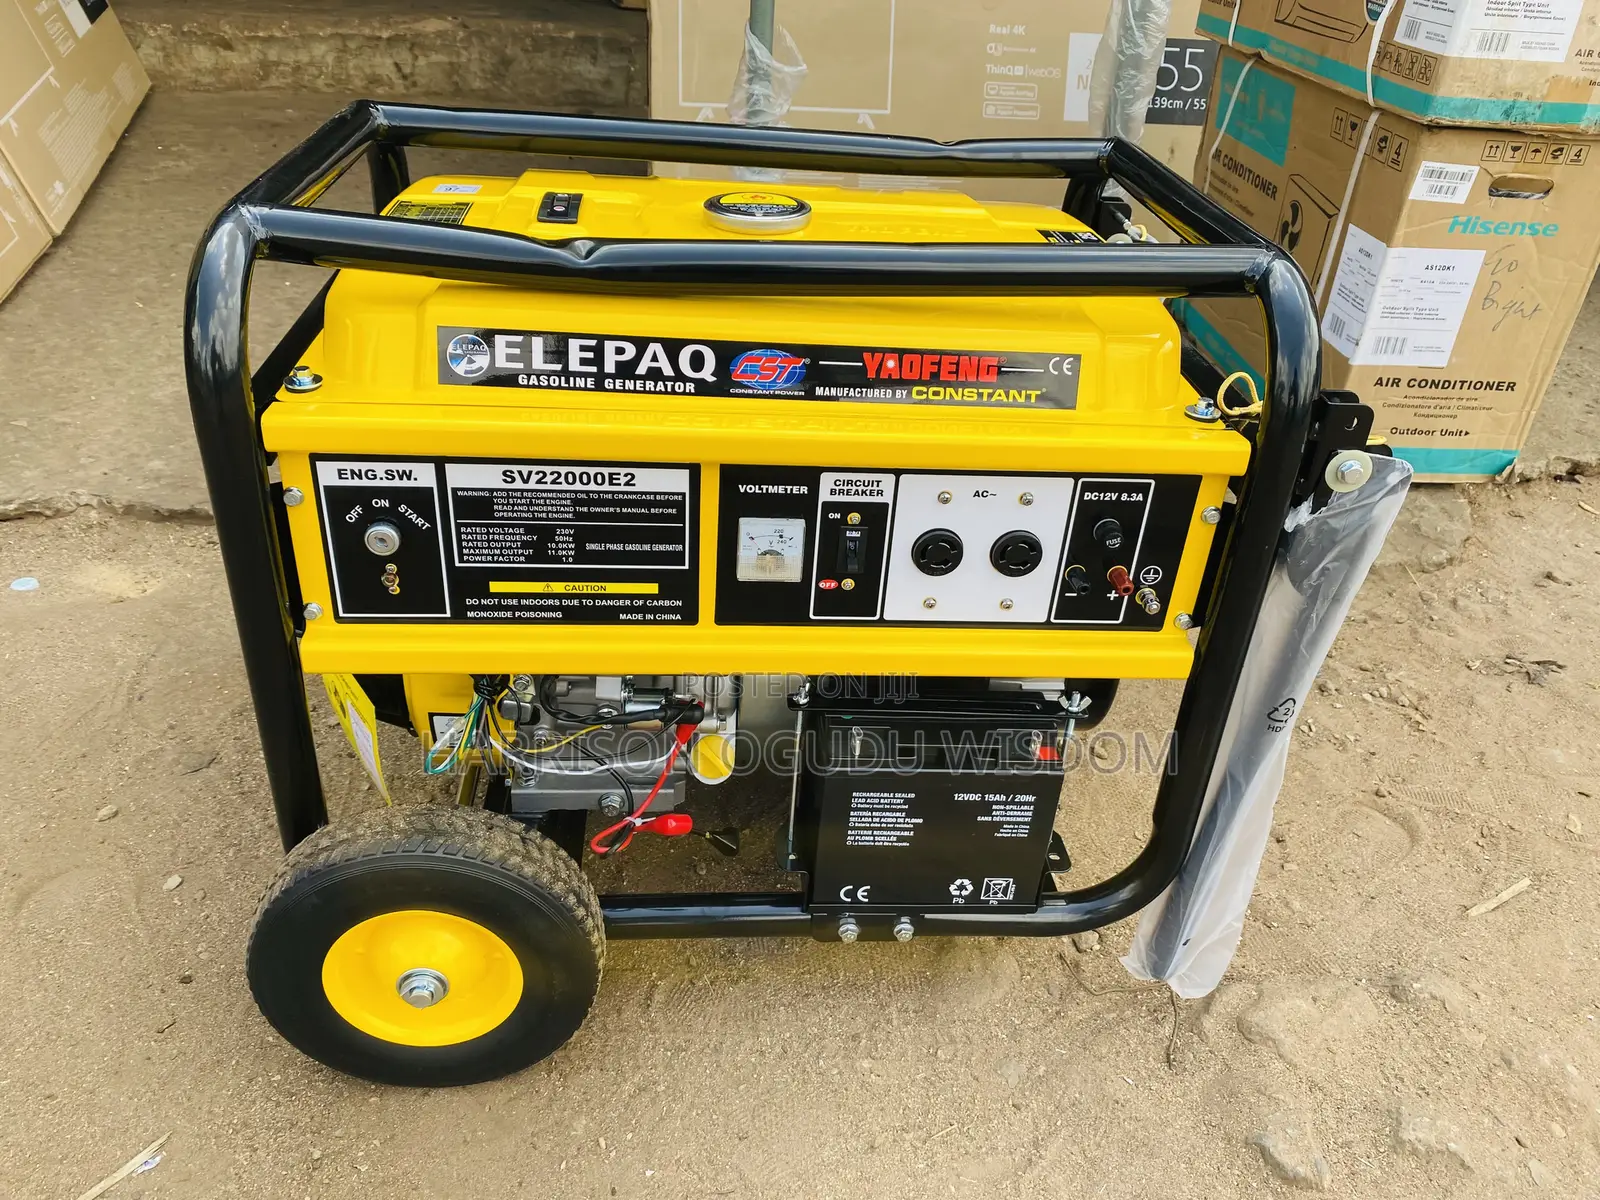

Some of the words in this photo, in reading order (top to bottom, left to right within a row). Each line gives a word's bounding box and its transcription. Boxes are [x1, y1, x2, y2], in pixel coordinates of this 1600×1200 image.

[989, 24, 1010, 34] Real
[1013, 25, 1026, 35] 4K
[1575, 48, 1595, 58] AIR
[985, 64, 1014, 76] ThinQ
[1156, 48, 1205, 91] 55
[1148, 96, 1183, 109] 139cm
[1573, 147, 1583, 159] 4
[1222, 154, 1278, 201] CONDITIONER
[1447, 215, 1559, 237] Hisense
[1424, 263, 1456, 272] AS12DK1
[494, 334, 718, 383] ELEPAQ
[731, 355, 806, 383] CST
[862, 352, 1000, 383] YAOFENG
[518, 374, 596, 389] GASOLINE
[604, 378, 696, 393] GENERATOR
[1373, 377, 1402, 388] AIR
[1406, 378, 1517, 392] CONDITIONER
[815, 386, 892, 399] MANUFACTURED
[895, 389, 908, 399] BY
[911, 386, 1042, 403] CONSTANT
[1382, 402, 1432, 410] Condizionatore
[1389, 426, 1437, 437] Outdoor
[1440, 428, 1464, 437] Unit
[337, 468, 418, 481] ENG.SW.
[501, 469, 636, 487] SV22000E2
[738, 484, 809, 495] VOLTMETER
[833, 479, 883, 488] CIRCUIT
[829, 488, 884, 497] BREAKER
[1083, 492, 1119, 500] DC12V
[1120, 492, 1144, 501] 8.3A
[371, 498, 390, 508] ON
[345, 504, 364, 523] OFF
[397, 503, 432, 531] START
[1106, 536, 1122, 546] FUSE
[585, 543, 605, 551] SINGLE
[605, 543, 624, 551] PHASE
[624, 543, 651, 551] GASOLINE
[652, 544, 683, 552] GENERATOR
[564, 584, 607, 592] CAUTION
[501, 598, 519, 606] USE
[520, 598, 560, 606] INDOORS
[632, 599, 645, 607] OF
[646, 599, 683, 607] CARBON
[953, 793, 982, 801] 12VDC
[984, 793, 1007, 802] 15Ah
[1014, 794, 1037, 802] 20Hr
